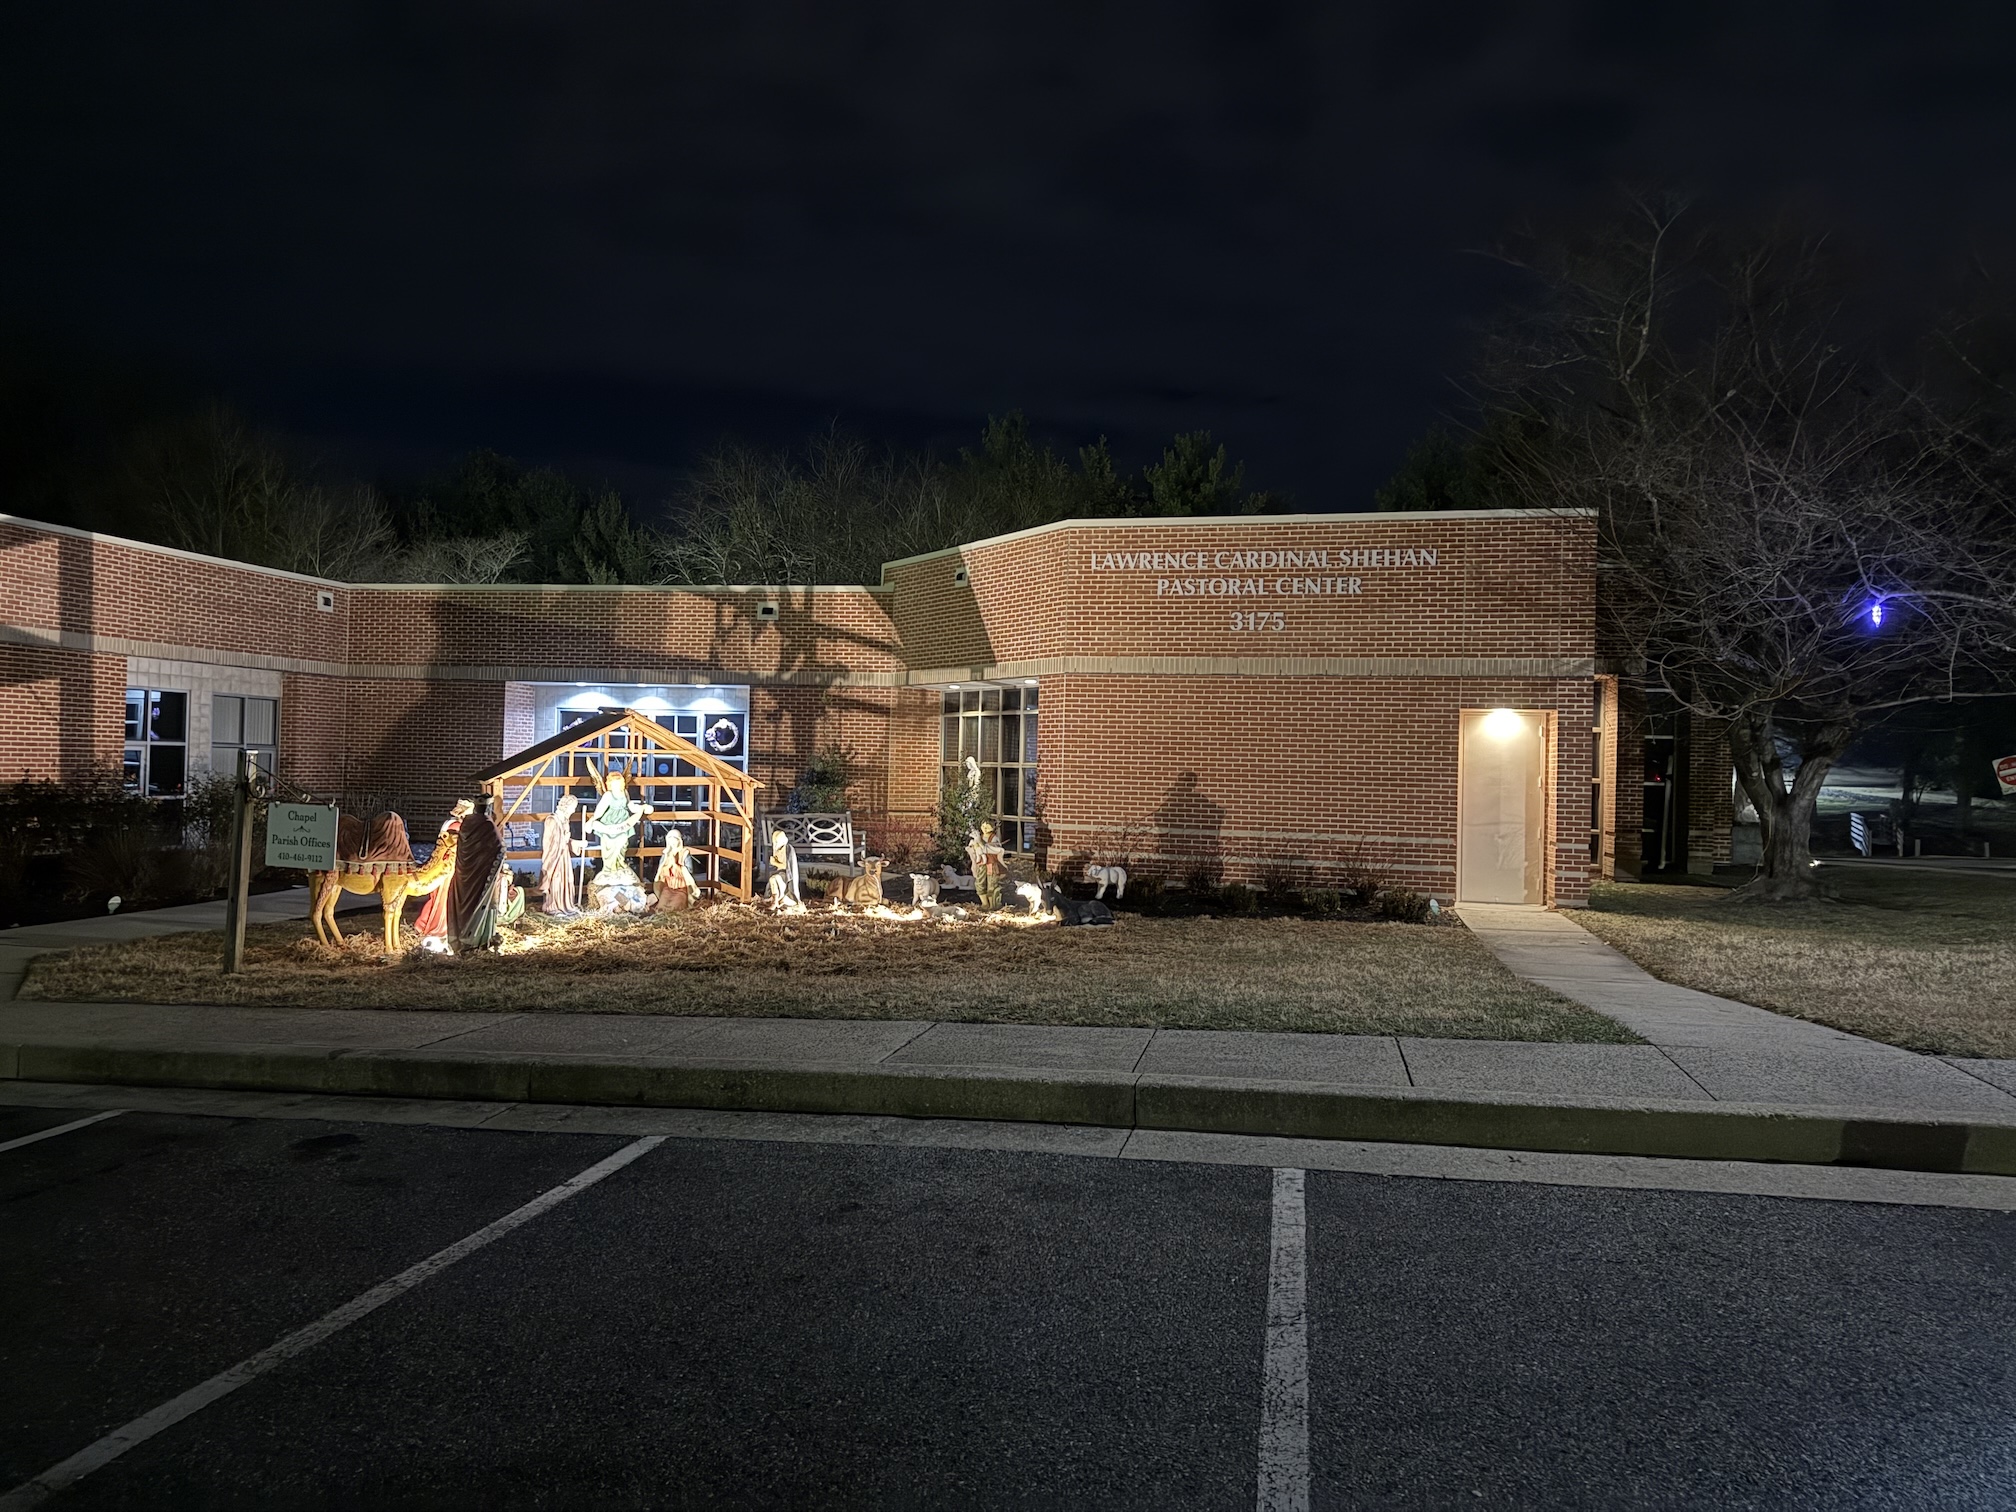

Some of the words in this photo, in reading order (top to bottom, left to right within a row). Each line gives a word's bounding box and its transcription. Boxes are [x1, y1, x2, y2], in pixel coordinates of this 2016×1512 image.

[1091, 551, 1209, 571] LAWRENCE
[1214, 550, 1333, 569] CARDINAL
[1339, 548, 1438, 567] SHEHAN
[1157, 577, 1269, 596] PASTORAL
[1275, 576, 1363, 595] CENTER
[1230, 611, 1285, 631] 3175
[288, 810, 317, 823] Chapel
[272, 834, 299, 846] Parish
[300, 836, 331, 849] Offices
[277, 852, 323, 863] 410-461-9112
